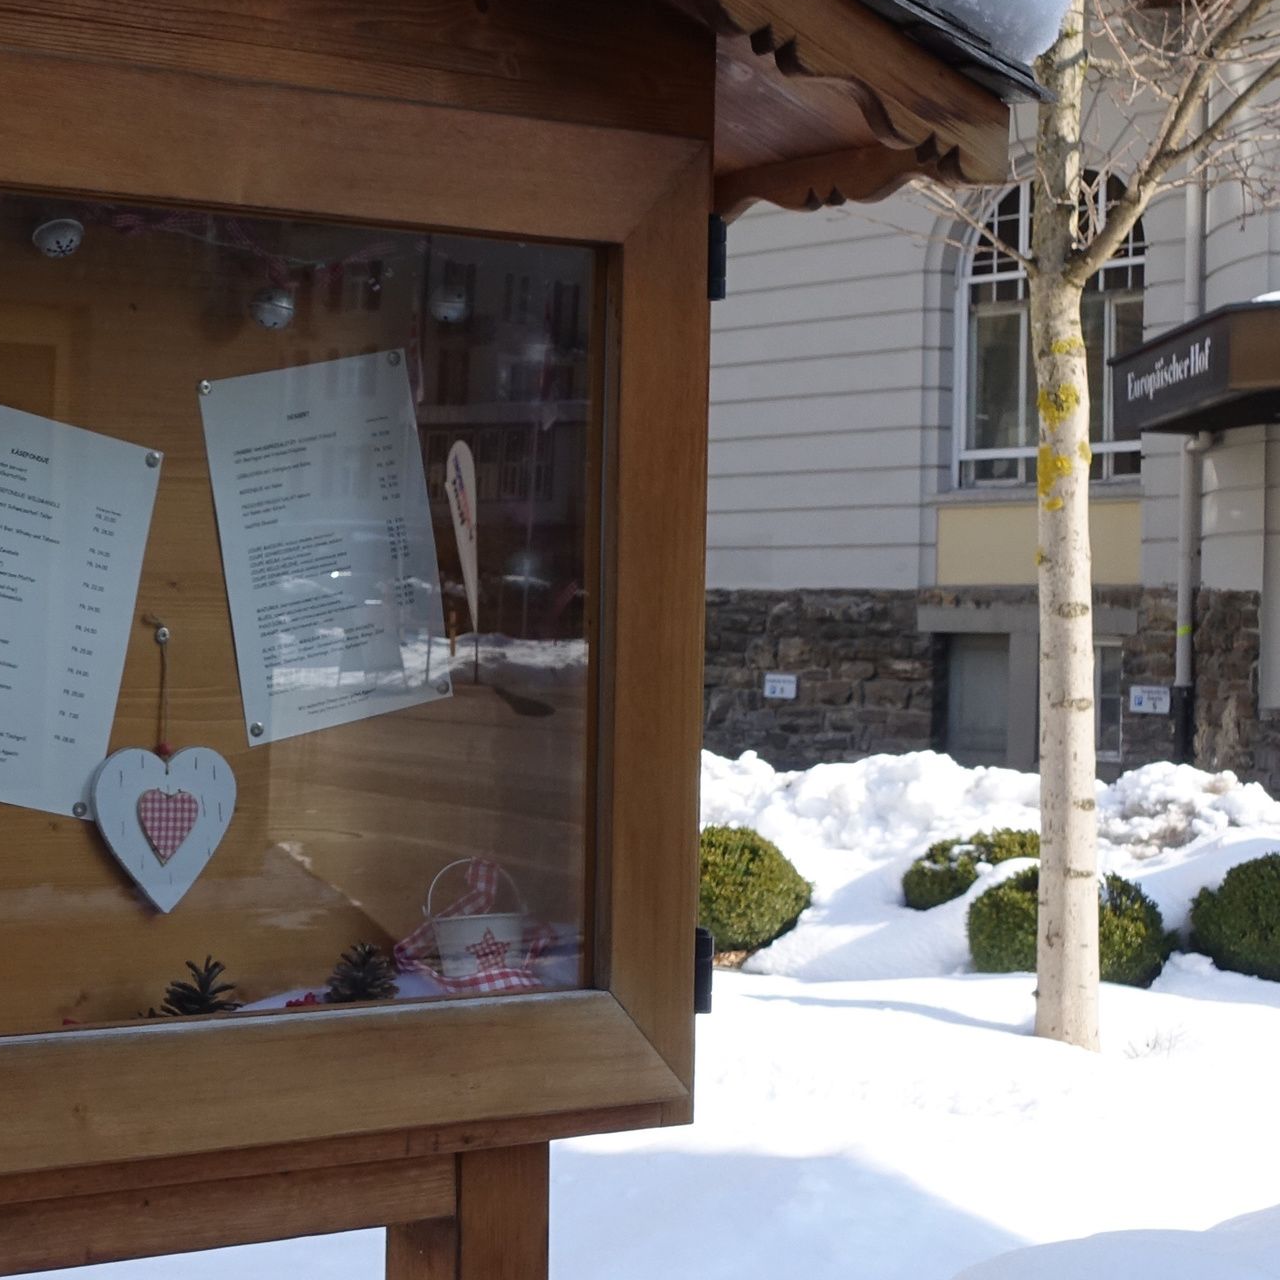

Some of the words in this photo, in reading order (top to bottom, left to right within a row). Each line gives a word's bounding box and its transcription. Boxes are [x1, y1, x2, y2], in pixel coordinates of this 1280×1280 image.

[1127, 353, 1189, 401] Europäischer
[1190, 337, 1211, 377] Hof
[10, 447, 49, 464] KÄSEFONDUE
